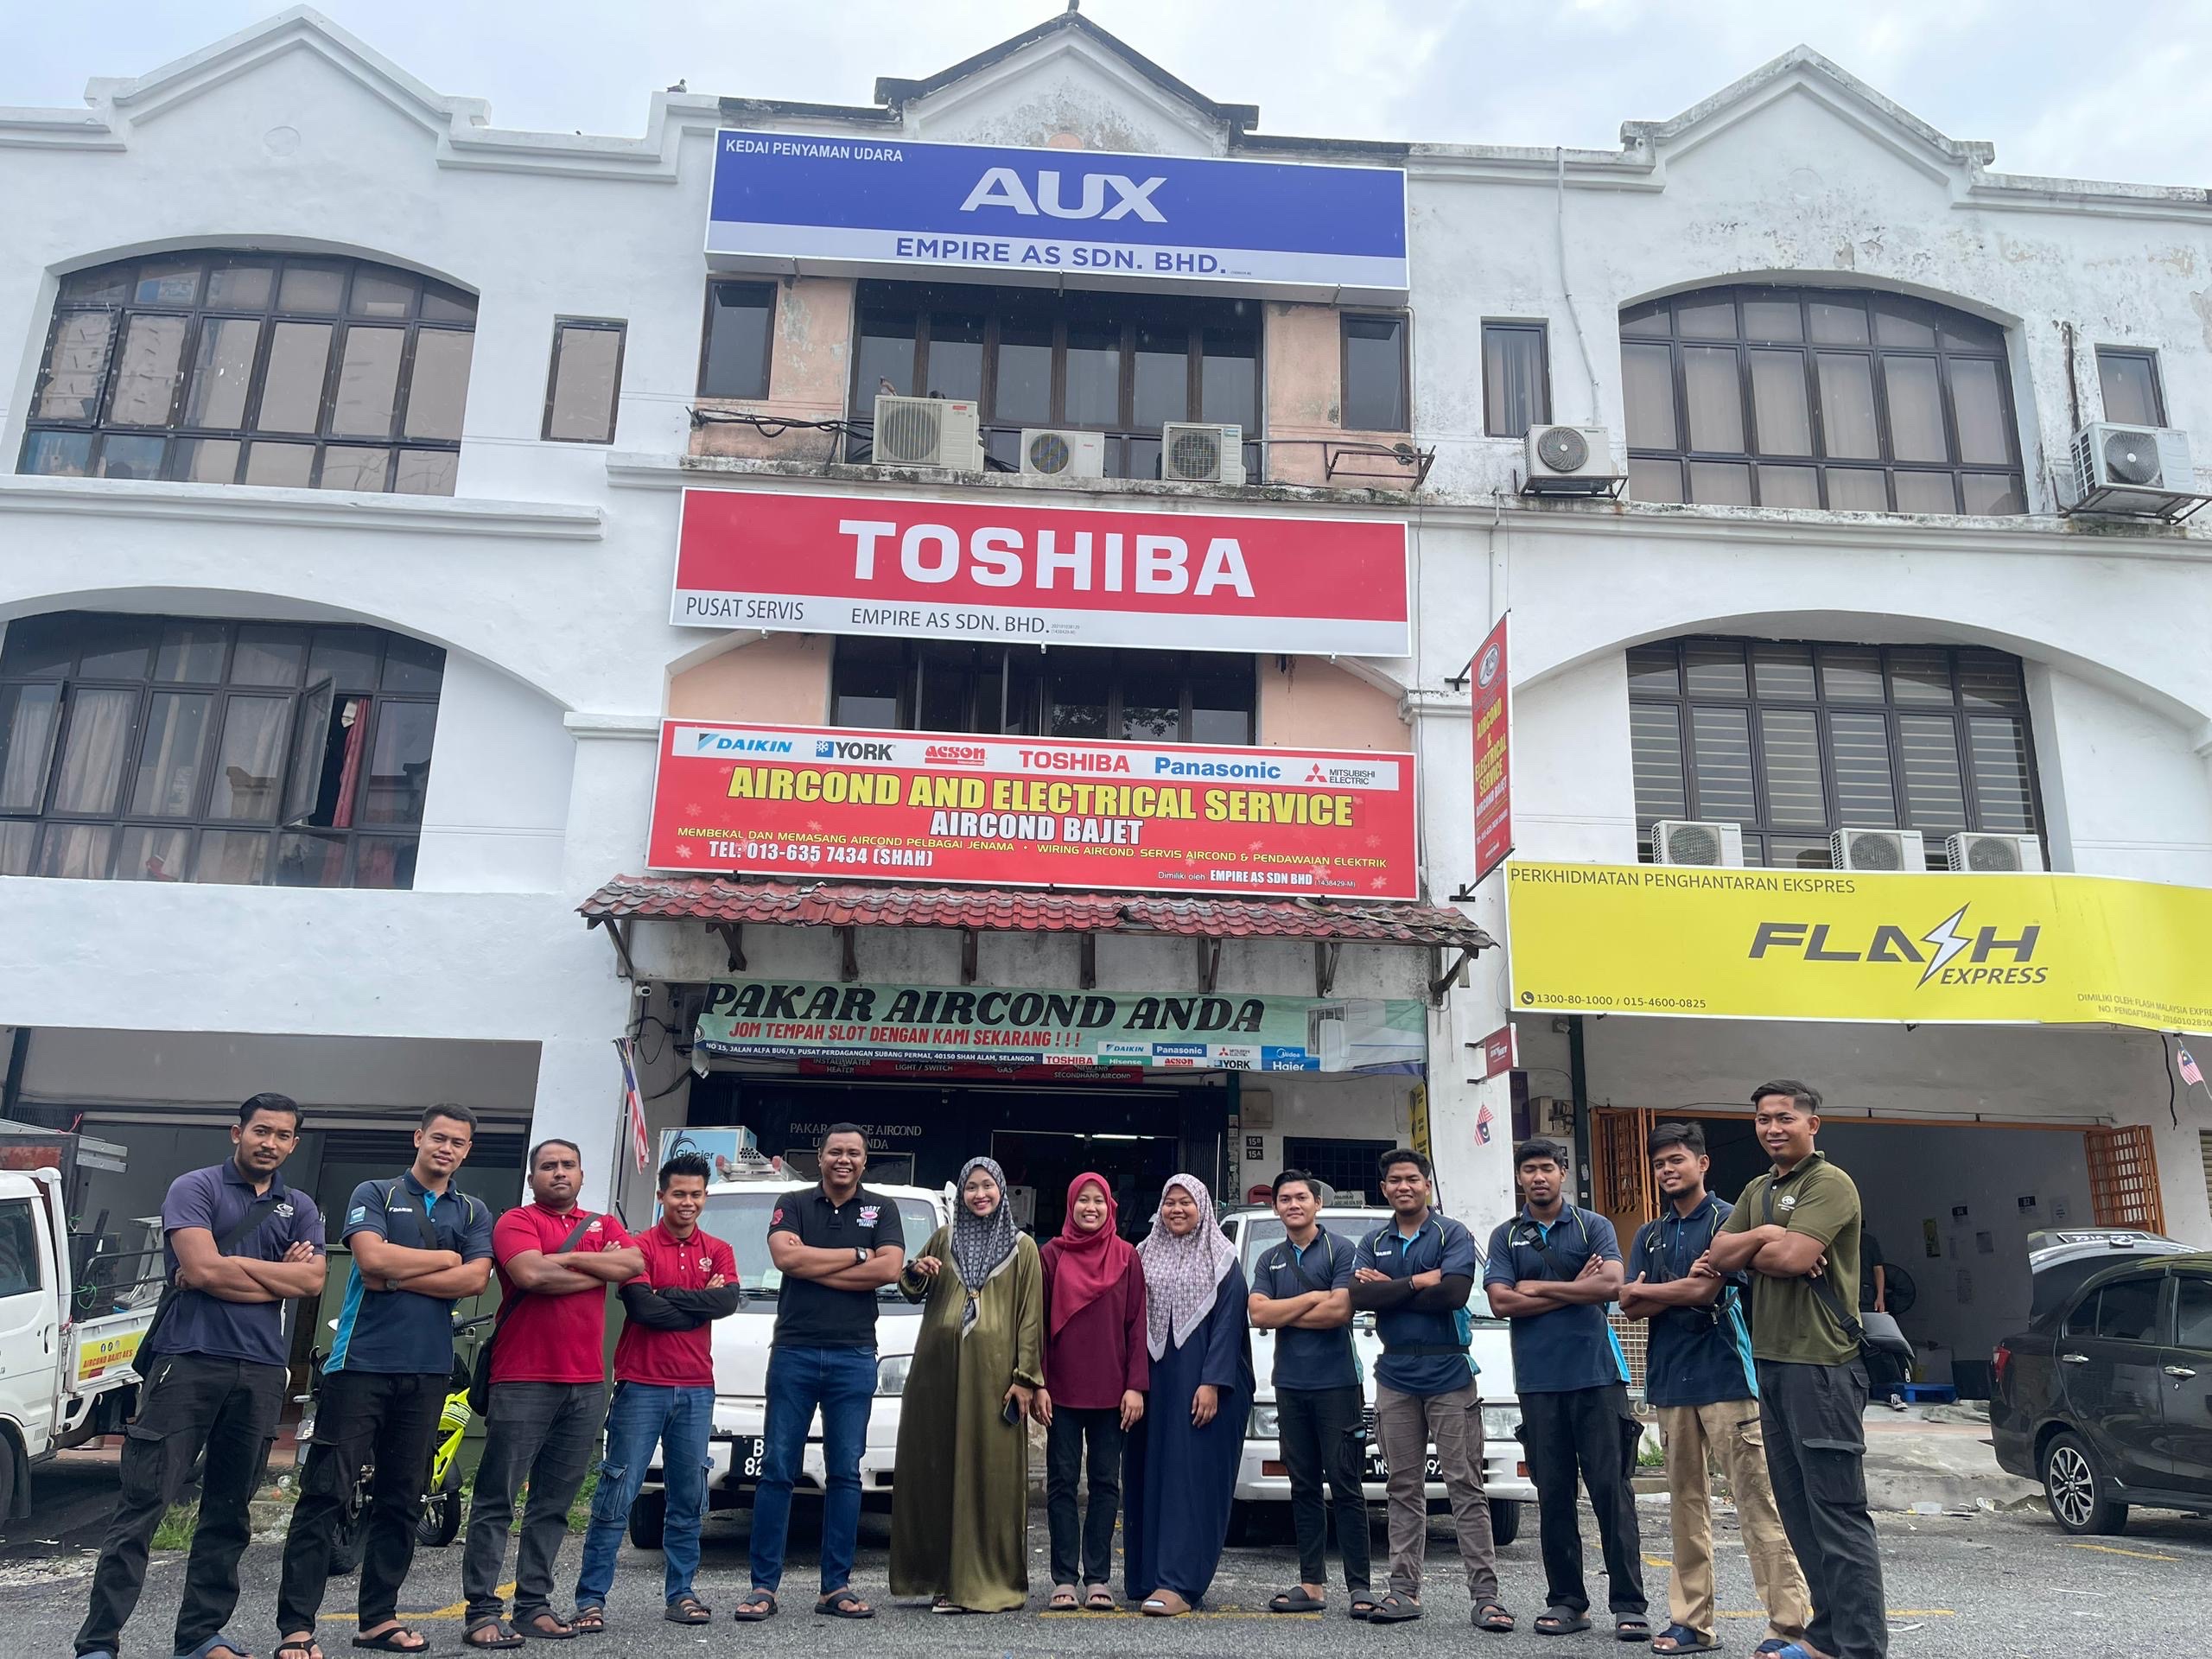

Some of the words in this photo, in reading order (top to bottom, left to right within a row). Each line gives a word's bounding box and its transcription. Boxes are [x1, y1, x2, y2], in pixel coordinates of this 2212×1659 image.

[725, 139, 769, 156] KEDAI
[772, 142, 850, 160] PENYAMAN
[853, 146, 904, 162] UDARA
[959, 167, 1168, 224] AUX
[895, 238, 1010, 262] EMPIRE
[1020, 245, 1060, 264] AS
[1071, 248, 1144, 270] SDN.
[1154, 251, 1227, 275] BHD.
[838, 519, 1255, 598] TOSHIBA
[686, 598, 741, 619] PUSAT
[746, 600, 804, 621] SERVIS
[851, 607, 920, 628] EMPIRE
[927, 610, 950, 629] AS
[954, 611, 1000, 632] SDN.
[1005, 614, 1050, 633] BHD.
[716, 738, 792, 753] DAIKIN
[836, 741, 893, 761] YORK
[1019, 750, 1130, 773] TOSHIBA
[1154, 756, 1282, 779] Panasonic
[1329, 768, 1376, 779] MITSUBISHI
[1329, 776, 1370, 785] ELECTRIC
[728, 766, 900, 806] AIRCOND
[907, 775, 986, 810] AND
[991, 779, 1198, 821] ELECTRICAL
[1205, 788, 1354, 827] SERVICE
[929, 810, 1055, 842] AIRCOND
[1062, 817, 1144, 846] BAJET
[677, 827, 744, 839] MEMBEKAL
[748, 830, 773, 841] DAN
[778, 832, 847, 844] MEMASANG
[851, 835, 903, 847] AIRCOND
[906, 838, 963, 849] PELBAGAI
[967, 842, 1014, 851] JENAMA
[1037, 844, 1079, 855] WIRING
[1140, 849, 1182, 860] SERVIS
[1185, 852, 1236, 862] AIRCOND
[1240, 853, 1249, 863] &
[1252, 854, 1331, 866] PENDAWAIAN
[1333, 857, 1388, 868] ELEKTRIK
[709, 841, 741, 858] TEL:
[747, 843, 822, 862] 013-635
[826, 847, 868, 864] 7434
[873, 849, 933, 868] (SHAH)
[1158, 871, 1186, 880] Dimiliki
[1210, 870, 1249, 882] EMPIRE
[1251, 871, 1265, 883] AS
[1267, 872, 1287, 884] SDN
[1291, 874, 1313, 886] BHD
[1510, 868, 1639, 887] PERKHIDMATAN
[1644, 873, 1778, 892] PENGHANTARAN
[1783, 878, 1856, 893] EKSPRES
[1940, 967, 2048, 985] EXPRESS
[702, 983, 875, 1022] PAKAR
[881, 988, 1116, 1029] AIRCOND
[1122, 997, 1265, 1033] ANDA
[1536, 994, 1613, 1006] 1300-80-1000
[1616, 996, 1620, 1006] /
[1623, 997, 1707, 1009] 015-4600-0825
[2077, 994, 2113, 1003] DIMILIKI
[2135, 999, 2155, 1008] FLASH
[2156, 1001, 2188, 1014] MALAYSIA
[729, 1021, 762, 1038] JOM
[765, 1024, 823, 1040] TEMPAH
[827, 1027, 863, 1042] SLOT
[869, 1027, 928, 1045] DENGAN
[931, 1030, 970, 1046] KAMI
[973, 1030, 1052, 1047] SEKARANG
[718, 1044, 728, 1052] 15,
[821, 1049, 873, 1058] PERDAGANGAN
[904, 1052, 932, 1060] PERMAI,
[976, 1054, 997, 1063] ALAM,
[999, 1055, 1035, 1064] SELANGOR
[1046, 1056, 1093, 1065] TOSHIBA
[1222, 1059, 1251, 1070] YORK
[1273, 1061, 1305, 1071] Haier
[1156, 1046, 1203, 1055] Panasonic
[1281, 1050, 1300, 1058] Midea
[790, 1122, 827, 1134] PAKAR
[875, 1125, 922, 1136] AIRCOND
